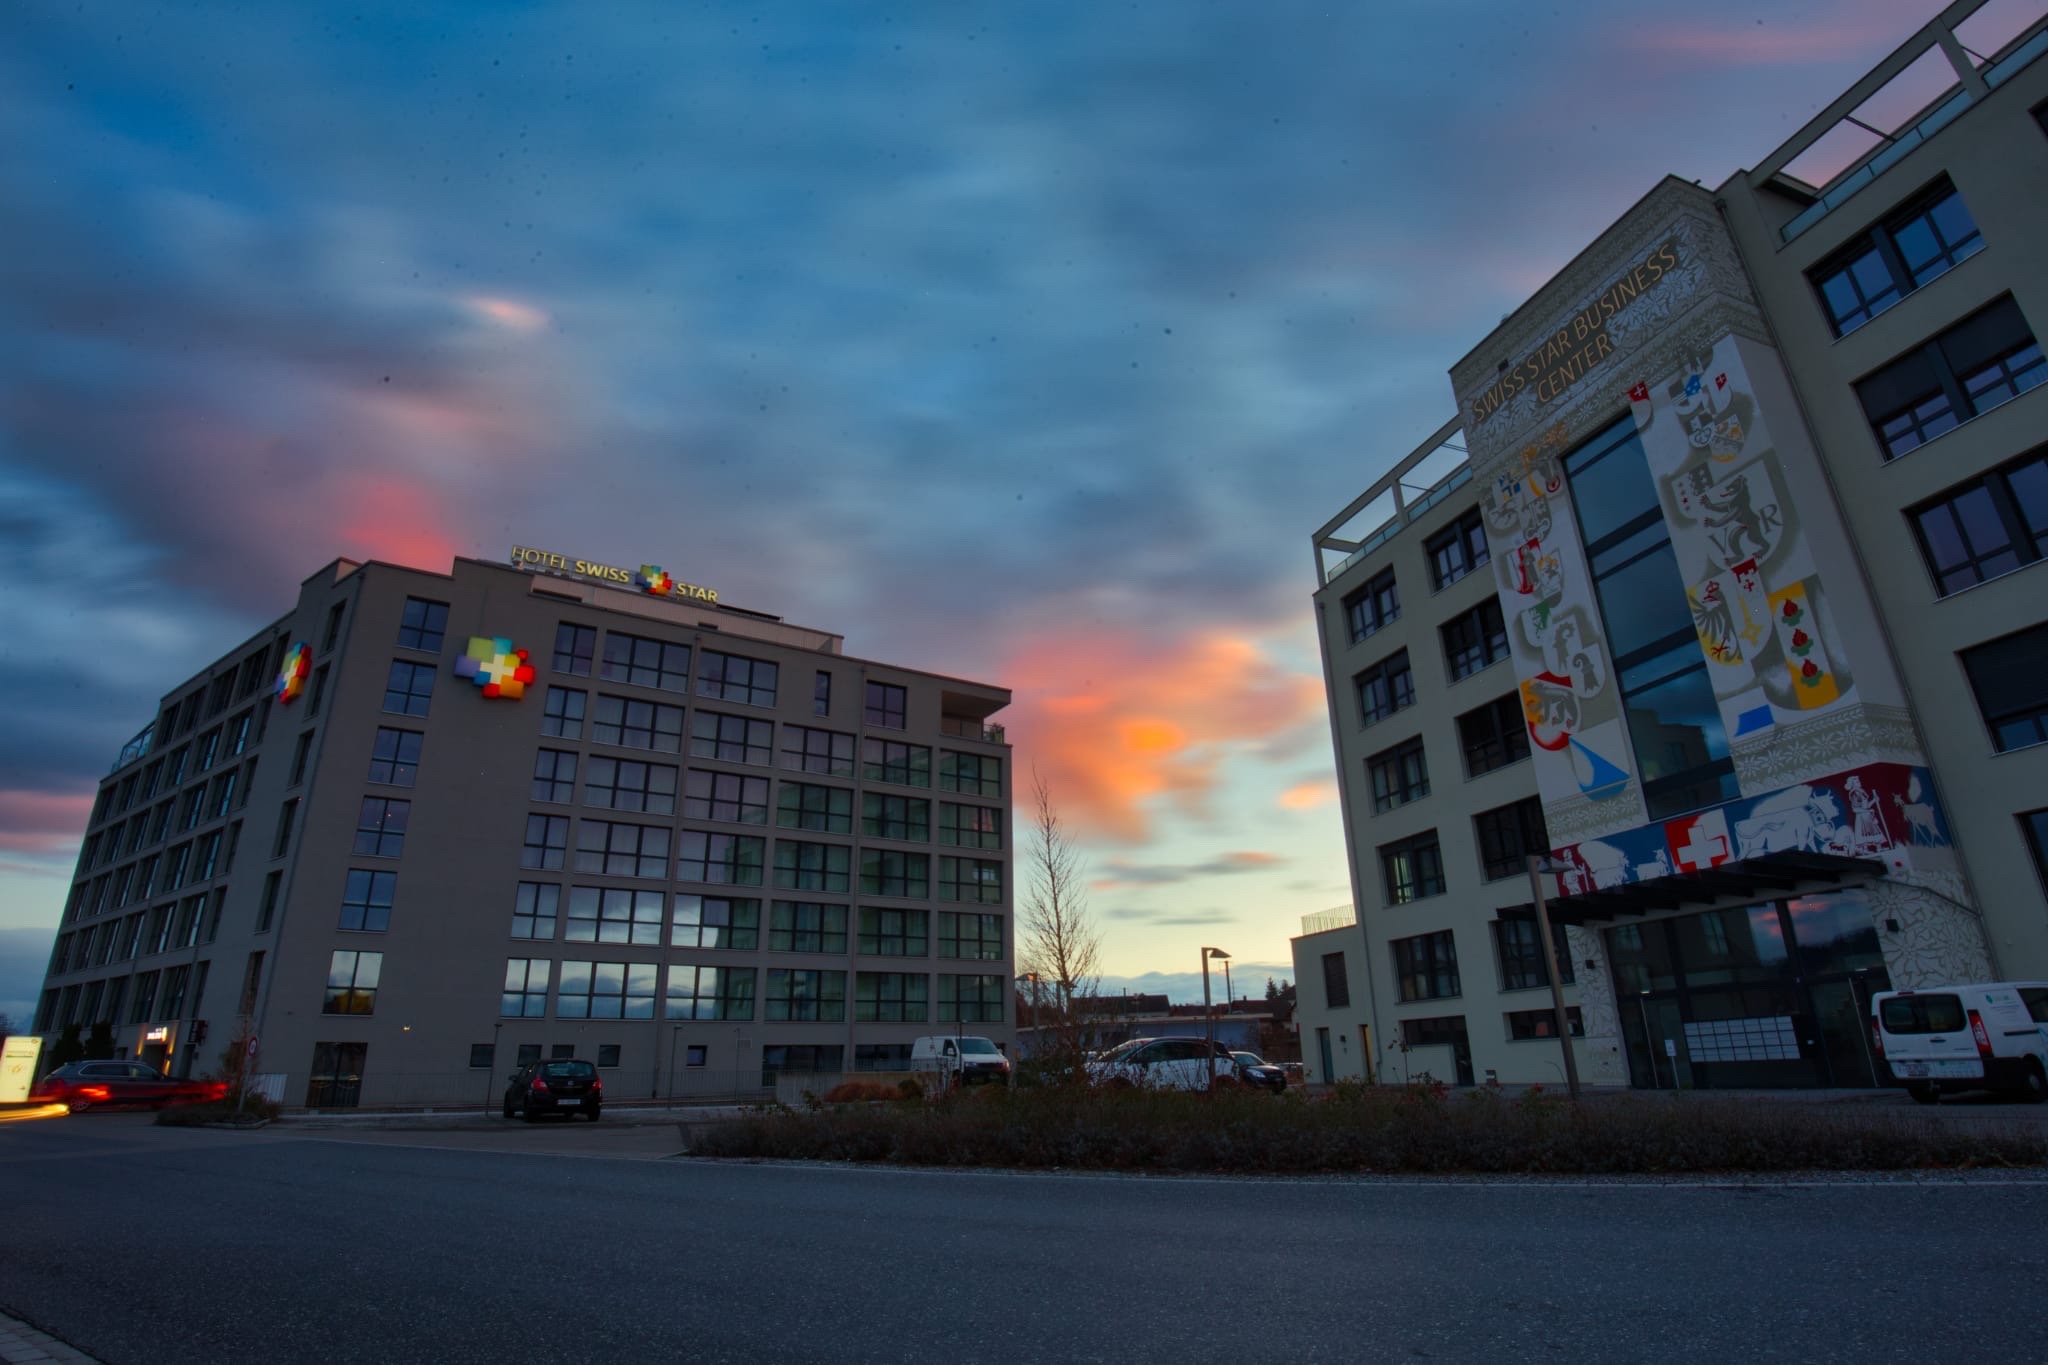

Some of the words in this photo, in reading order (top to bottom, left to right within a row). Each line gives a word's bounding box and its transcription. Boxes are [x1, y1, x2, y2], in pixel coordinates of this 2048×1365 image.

[1472, 367, 1525, 422] SWISS
[1526, 330, 1573, 380] STAR
[1573, 243, 1677, 341] BUSINESS
[1536, 333, 1614, 403] CENTER
[511, 546, 568, 571] HOTEL
[575, 560, 630, 583] SWISS
[676, 583, 719, 602] STAR
